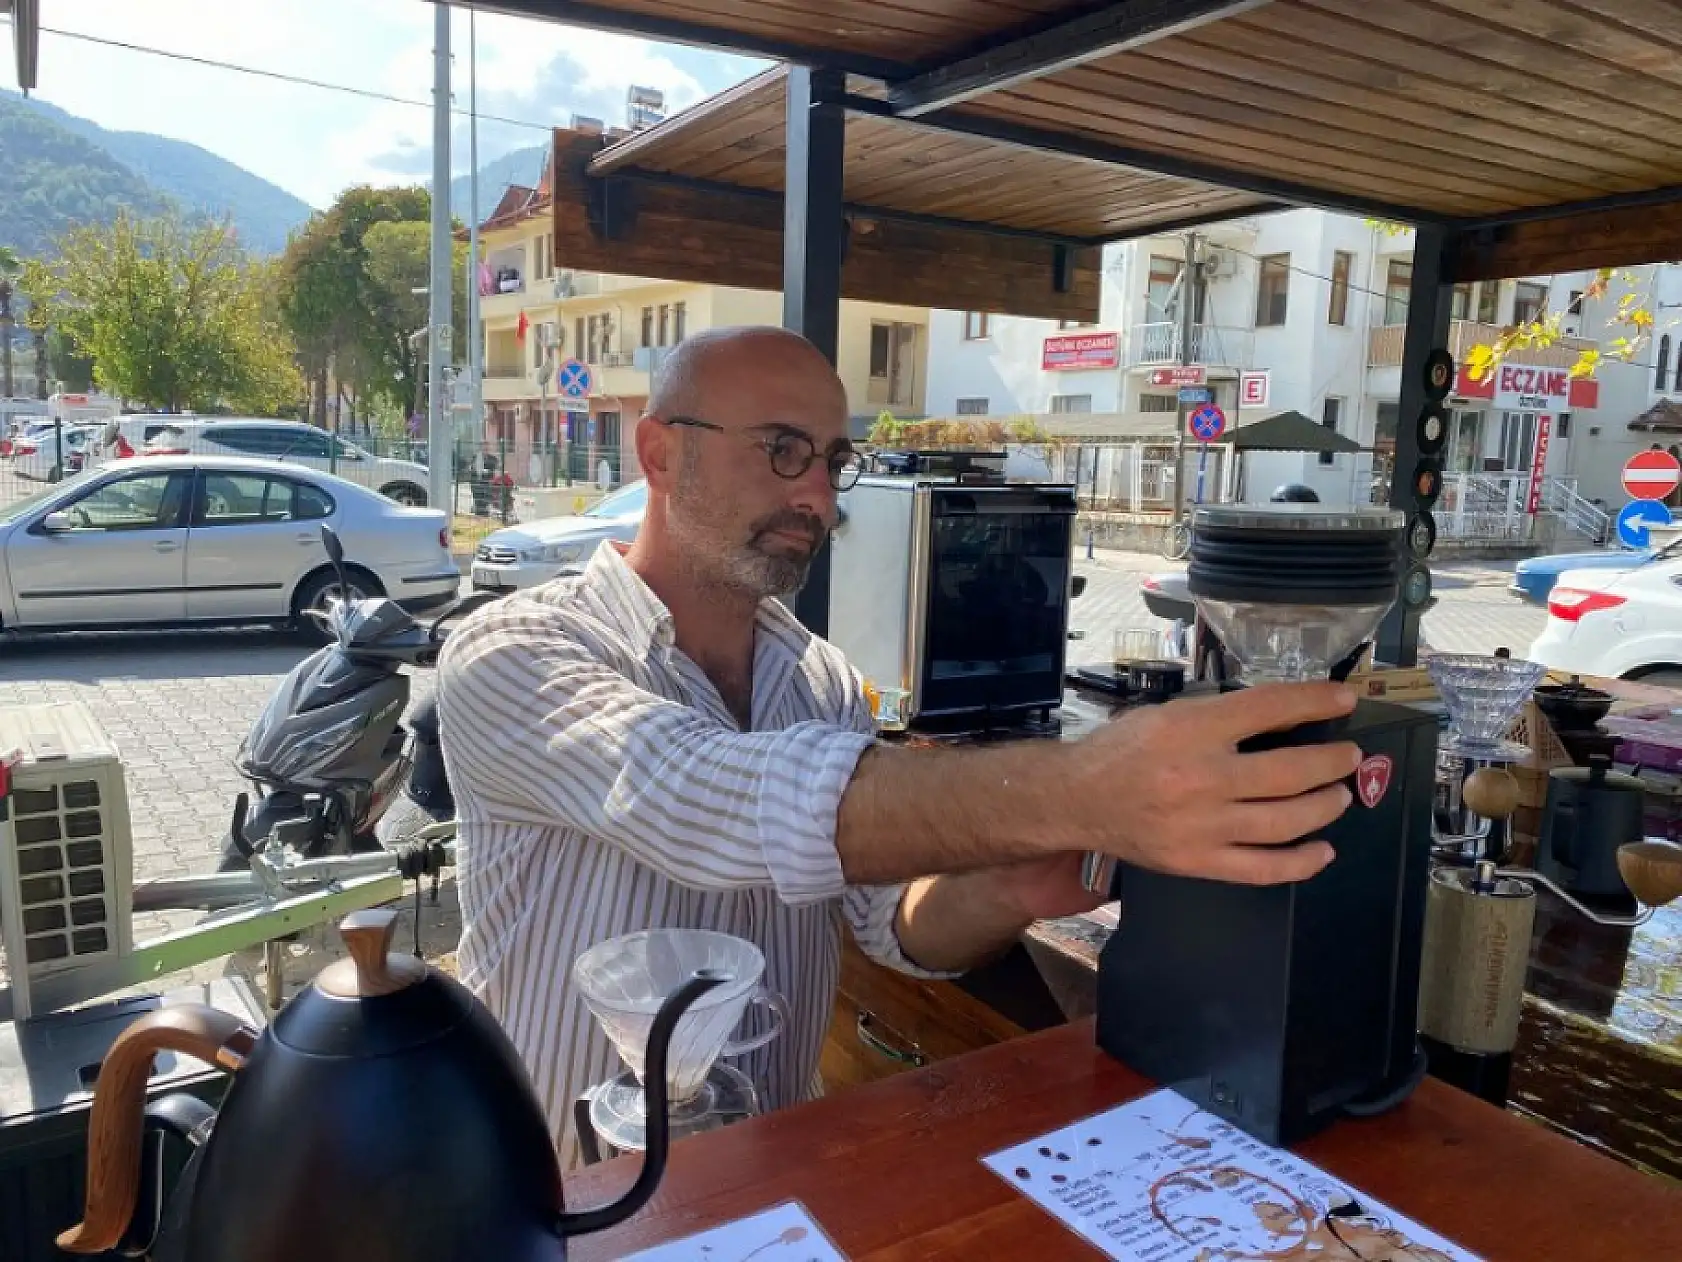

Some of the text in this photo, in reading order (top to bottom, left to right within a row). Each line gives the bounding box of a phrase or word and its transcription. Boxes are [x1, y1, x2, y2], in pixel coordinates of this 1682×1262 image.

[1247, 380, 1261, 400] E
[1501, 367, 1567, 396] ECZANE
[1532, 421, 1549, 509] ECZANE
